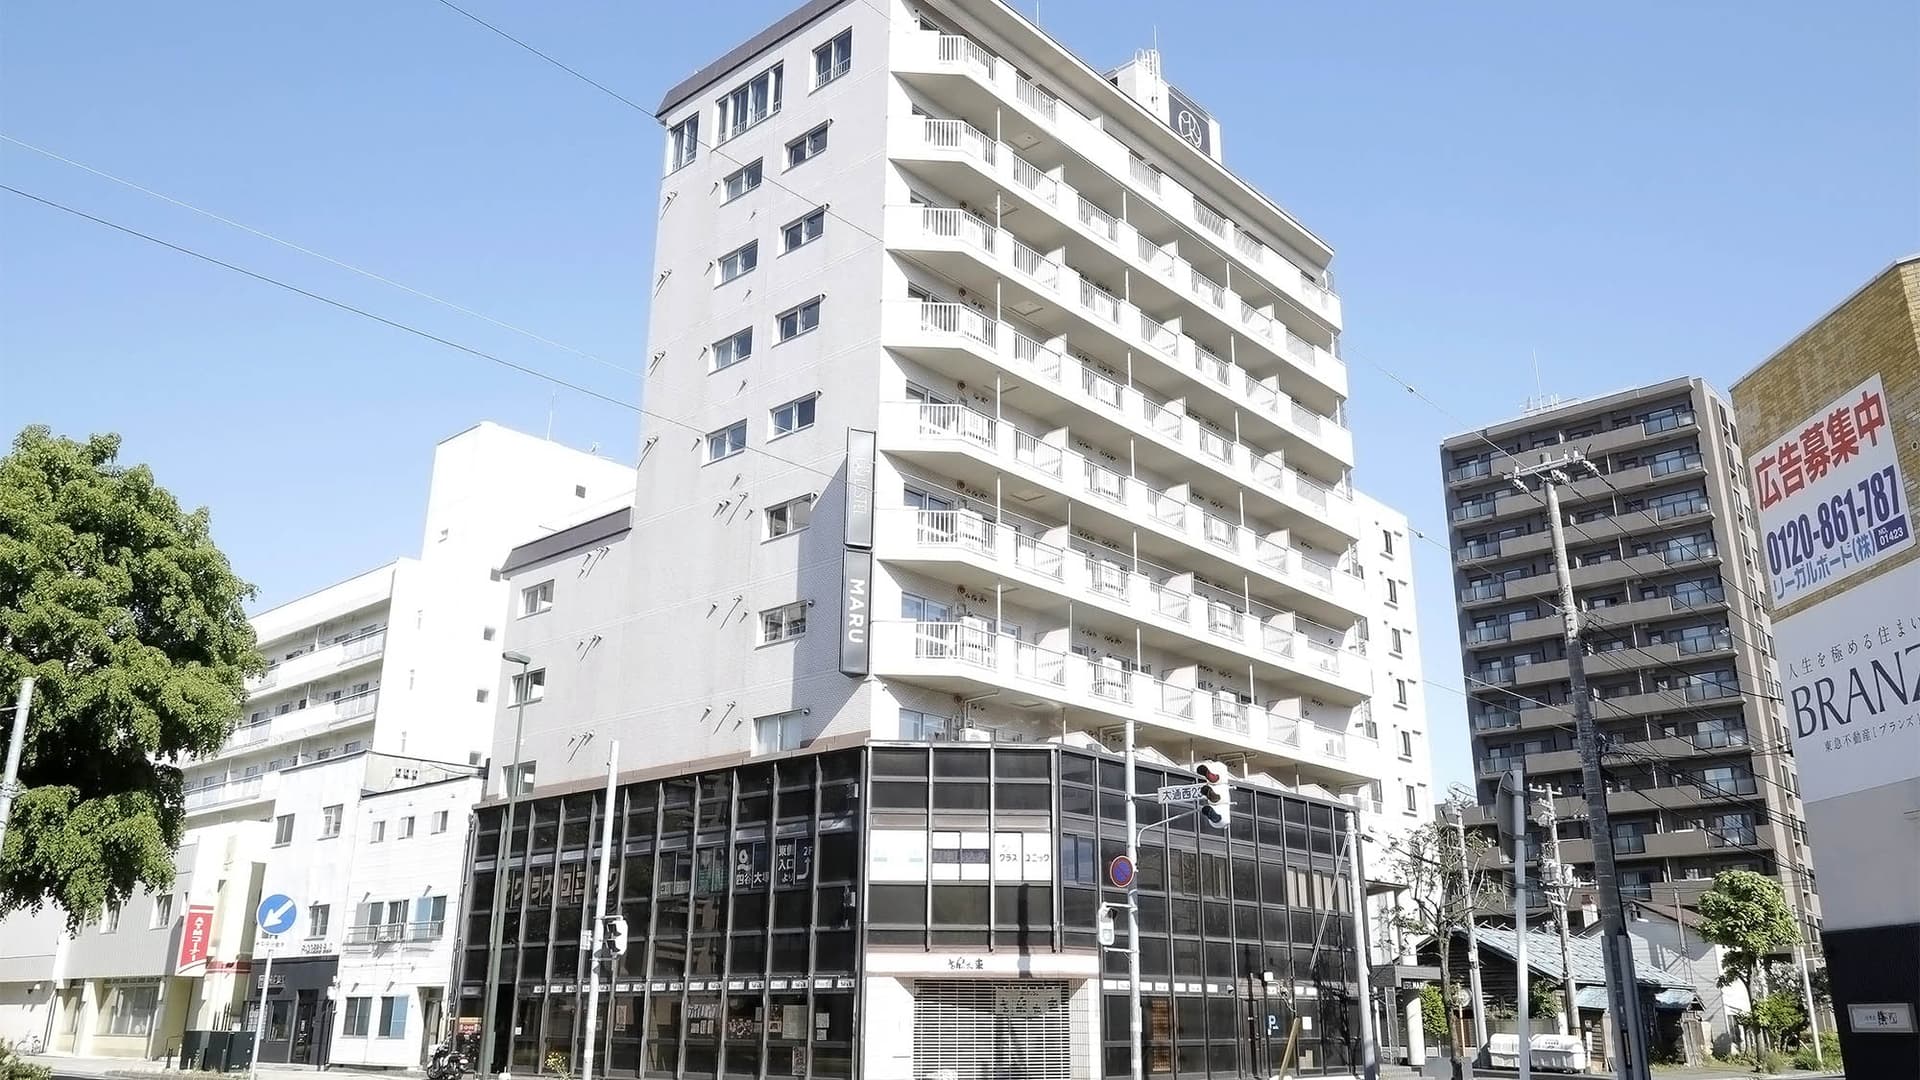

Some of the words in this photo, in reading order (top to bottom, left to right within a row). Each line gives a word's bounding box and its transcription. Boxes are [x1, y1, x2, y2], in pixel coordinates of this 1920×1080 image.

[1755, 391, 1885, 511] 広告募集中
[1767, 465, 1900, 576] 0120-861-787
[1880, 526, 1904, 546] 01423
[1773, 530, 1876, 600] リーガルボード(株)
[848, 578, 865, 643] MARU
[778, 858, 794, 871] 入口
